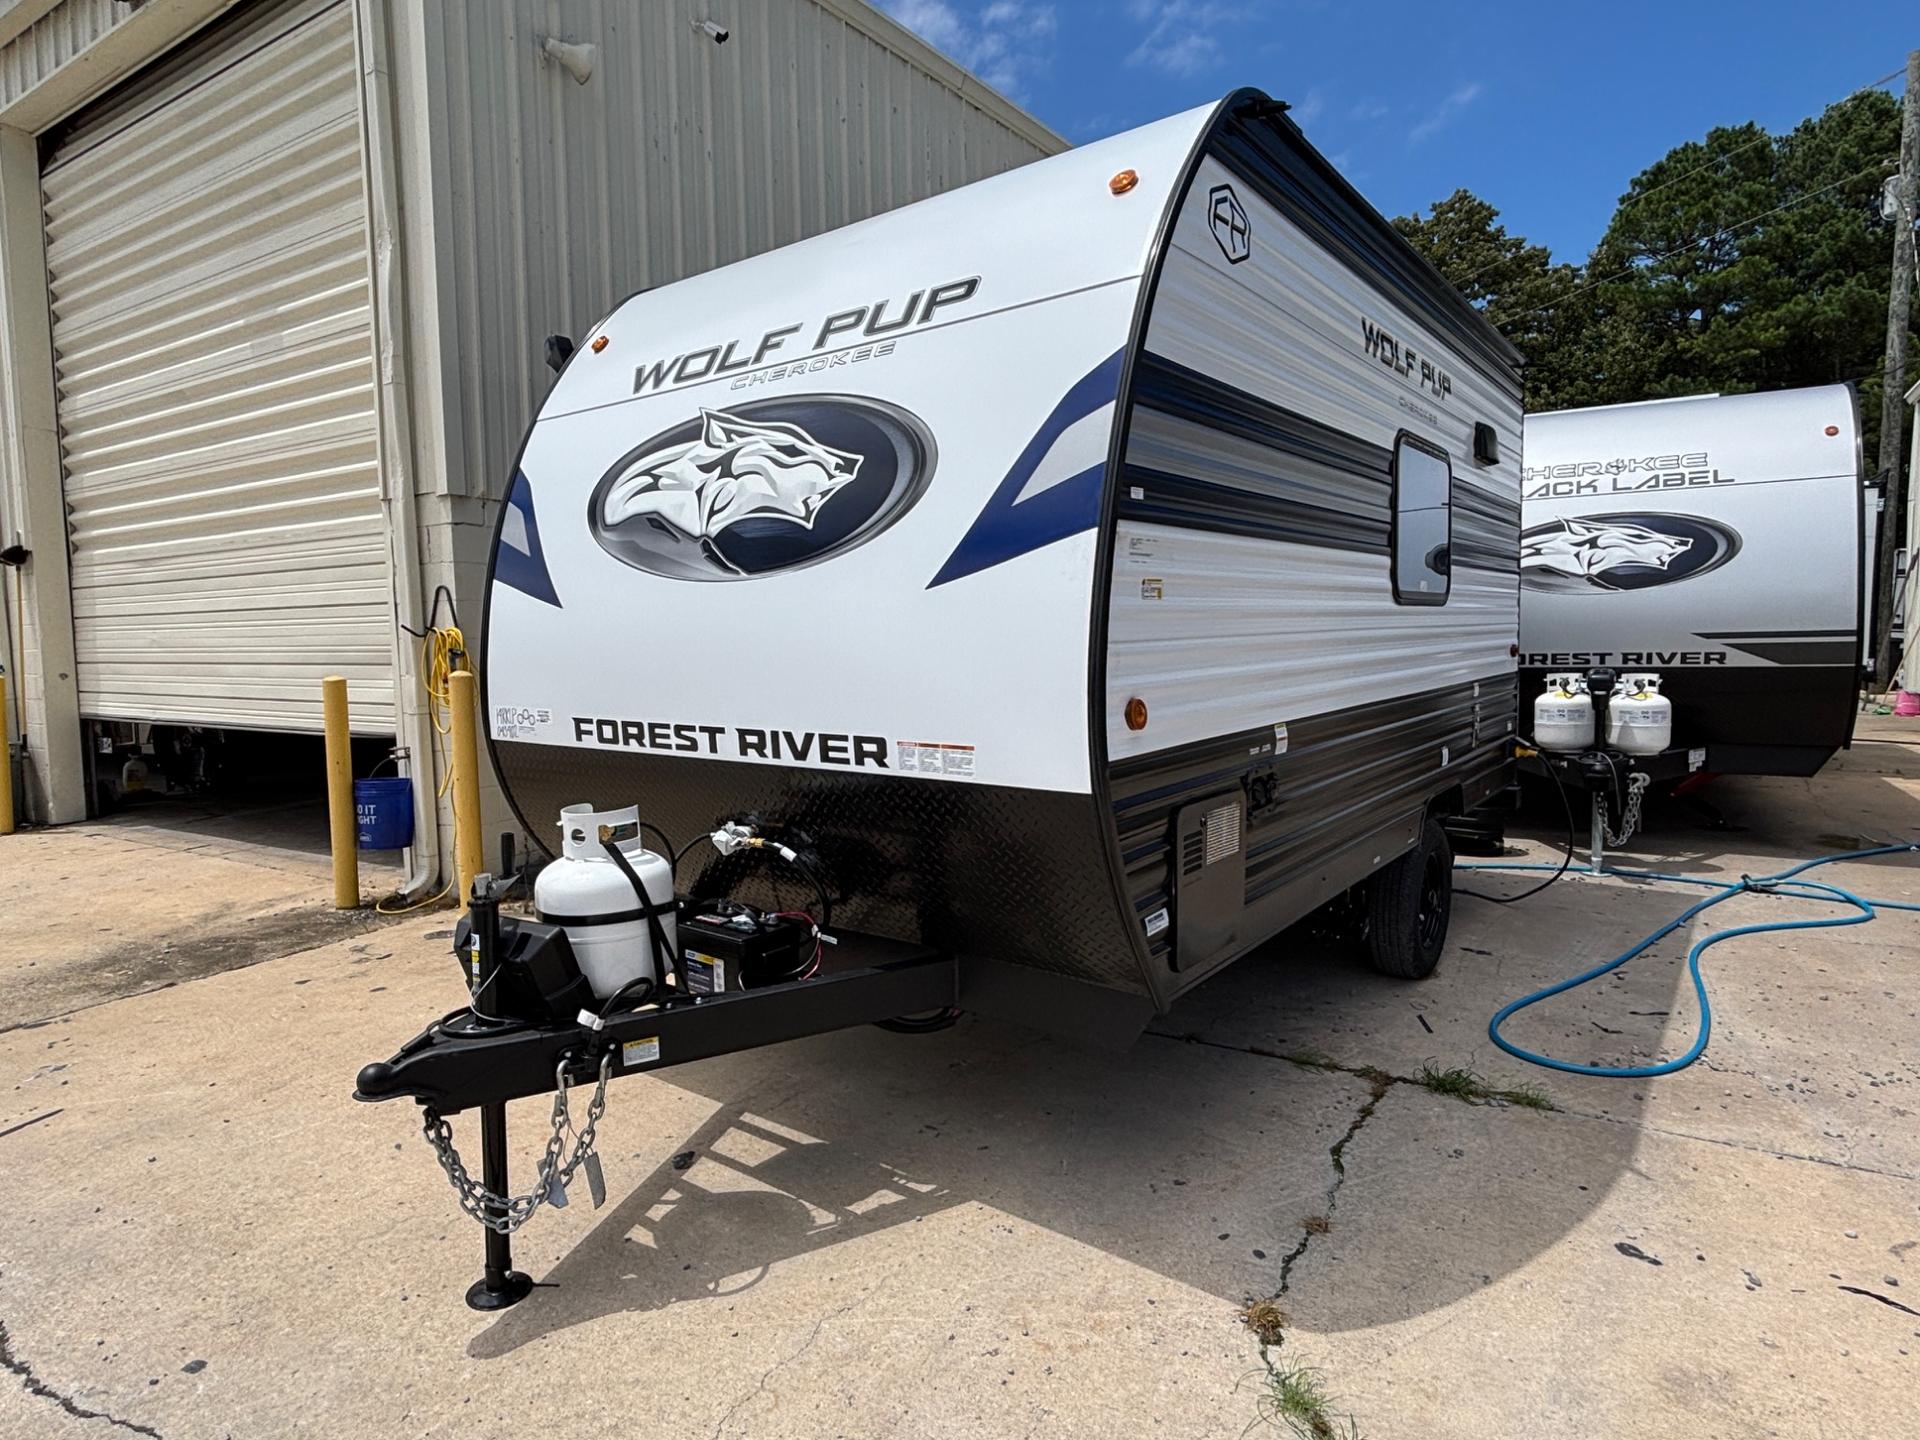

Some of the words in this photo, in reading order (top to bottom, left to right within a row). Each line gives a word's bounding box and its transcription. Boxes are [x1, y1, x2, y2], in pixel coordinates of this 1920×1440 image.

[632, 322, 803, 395] WOLF
[811, 274, 982, 351] PUP
[730, 340, 897, 391] CHEROKEE
[1361, 316, 1417, 379] WOLF
[1420, 358, 1452, 401] PUP
[1524, 478, 1600, 498] ACK
[1611, 469, 1736, 492] LABEL
[1620, 651, 1728, 665] RIVER
[571, 716, 726, 755] FOREST
[734, 727, 891, 769] RIVER
[357, 815, 377, 825] GHT
[365, 804, 377, 815] IT
